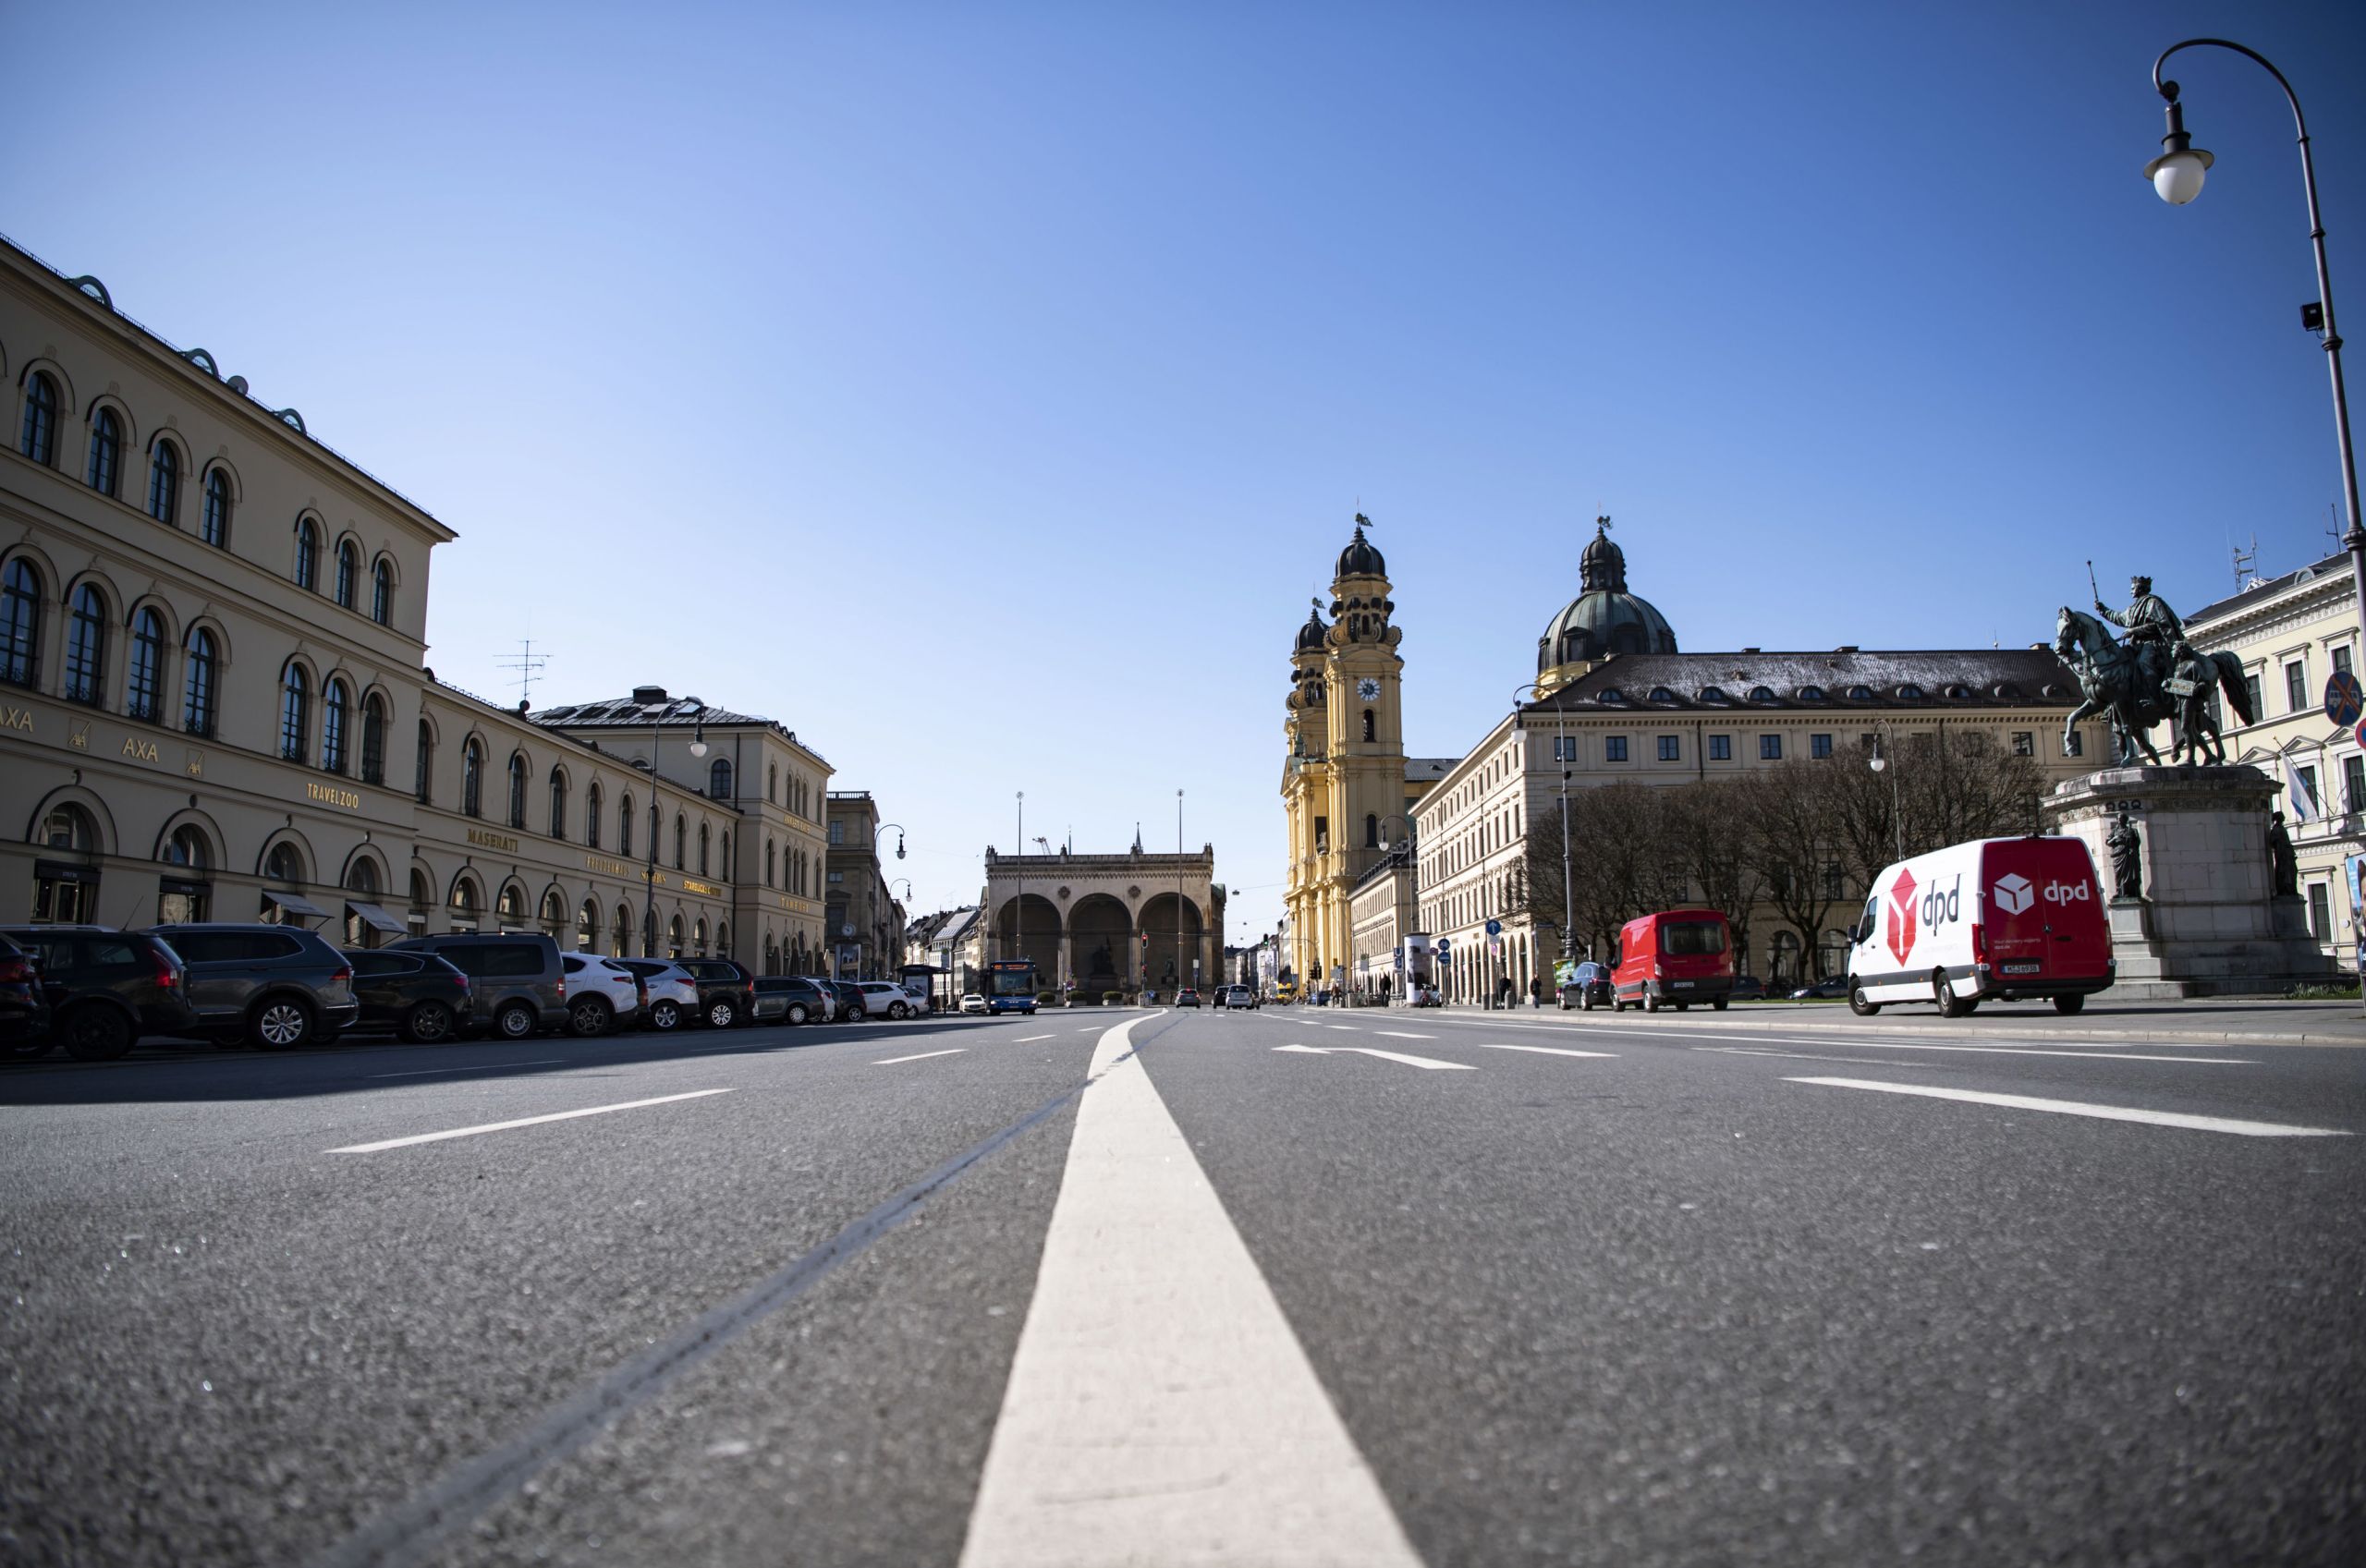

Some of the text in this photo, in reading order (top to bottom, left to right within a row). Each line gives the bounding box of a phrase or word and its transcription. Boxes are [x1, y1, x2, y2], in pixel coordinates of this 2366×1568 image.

[122, 738, 158, 762] AXA
[307, 783, 359, 809] TRAVELZOO
[467, 829, 518, 852] MASERATI
[1922, 874, 1960, 937] dpd
[2043, 880, 2090, 906] dpd
